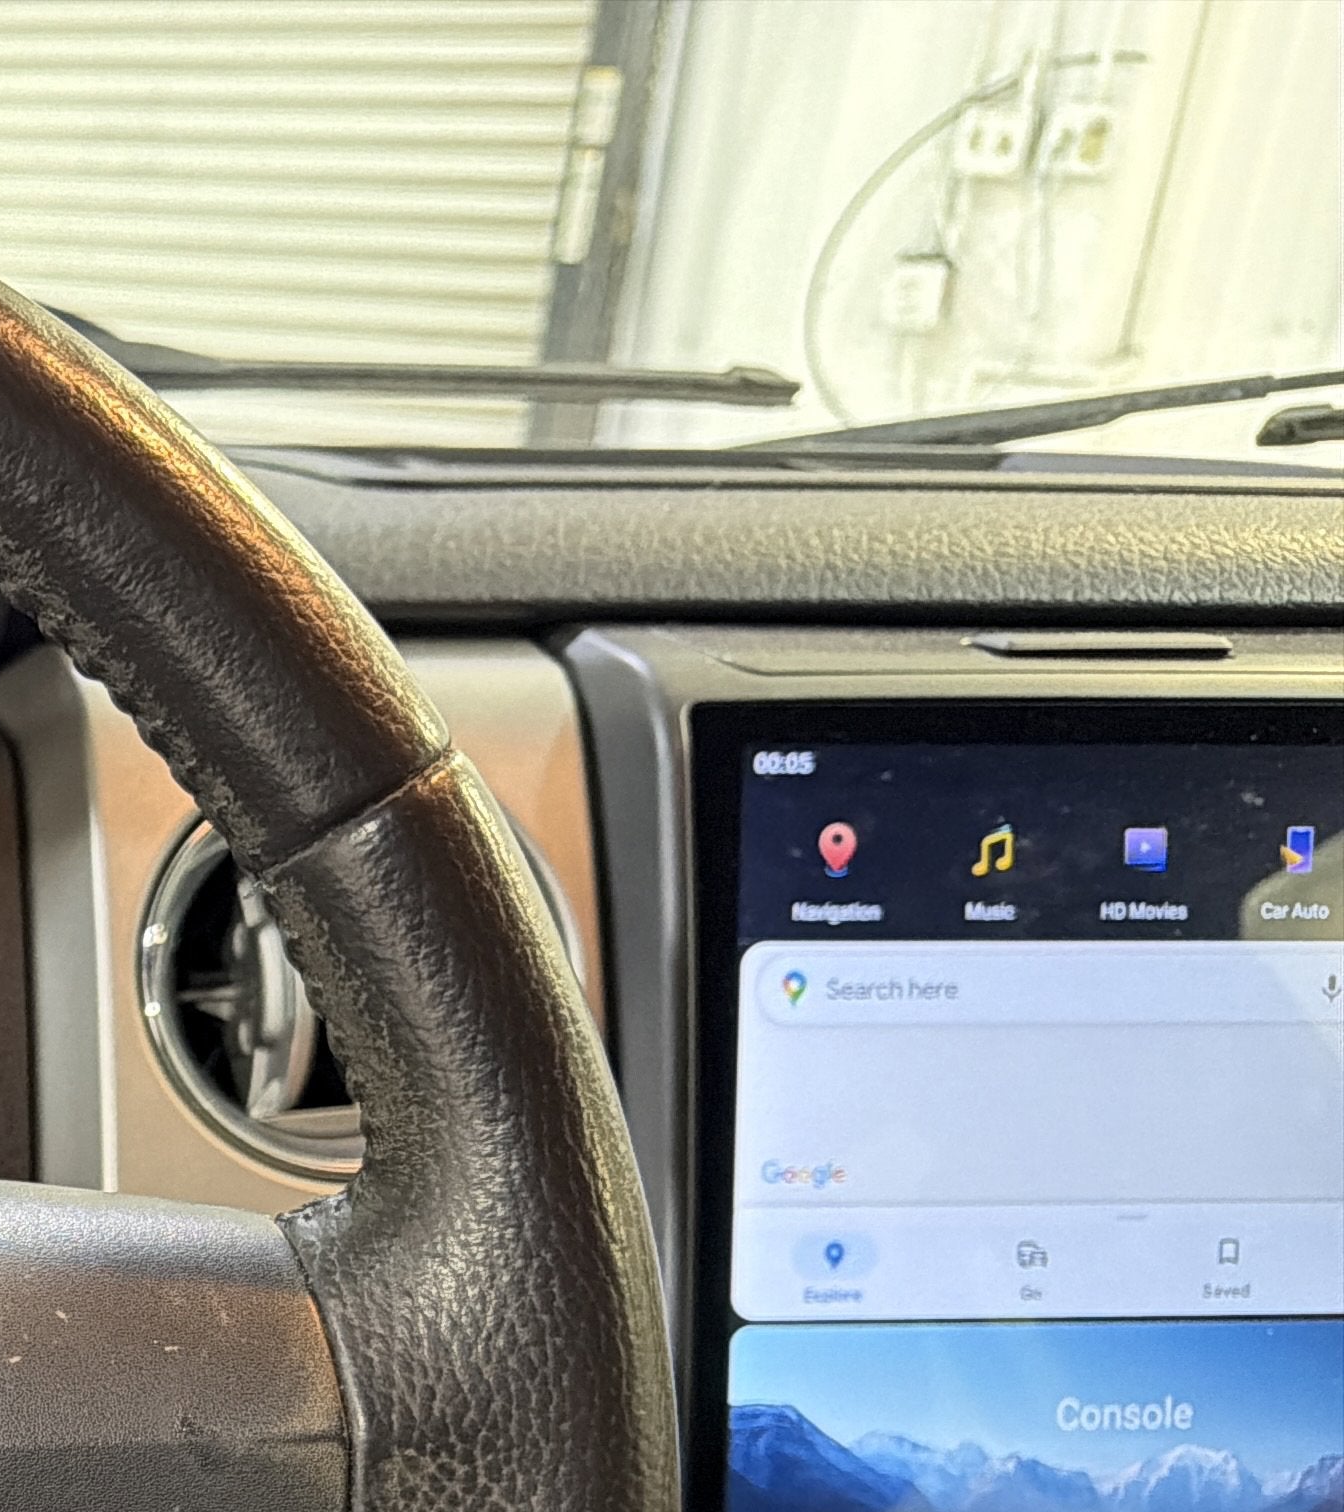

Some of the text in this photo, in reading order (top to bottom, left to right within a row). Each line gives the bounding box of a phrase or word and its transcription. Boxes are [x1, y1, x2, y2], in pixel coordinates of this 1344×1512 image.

[791, 902, 882, 925] Navigation
[965, 902, 1016, 922] Music
[1101, 902, 1188, 921] HD Movies
[1261, 903, 1330, 920] Car Auto
[825, 977, 959, 1001] Search here
[761, 1161, 846, 1187] Google
[1202, 1283, 1250, 1299] Saved
[1056, 1396, 1194, 1432] Console
